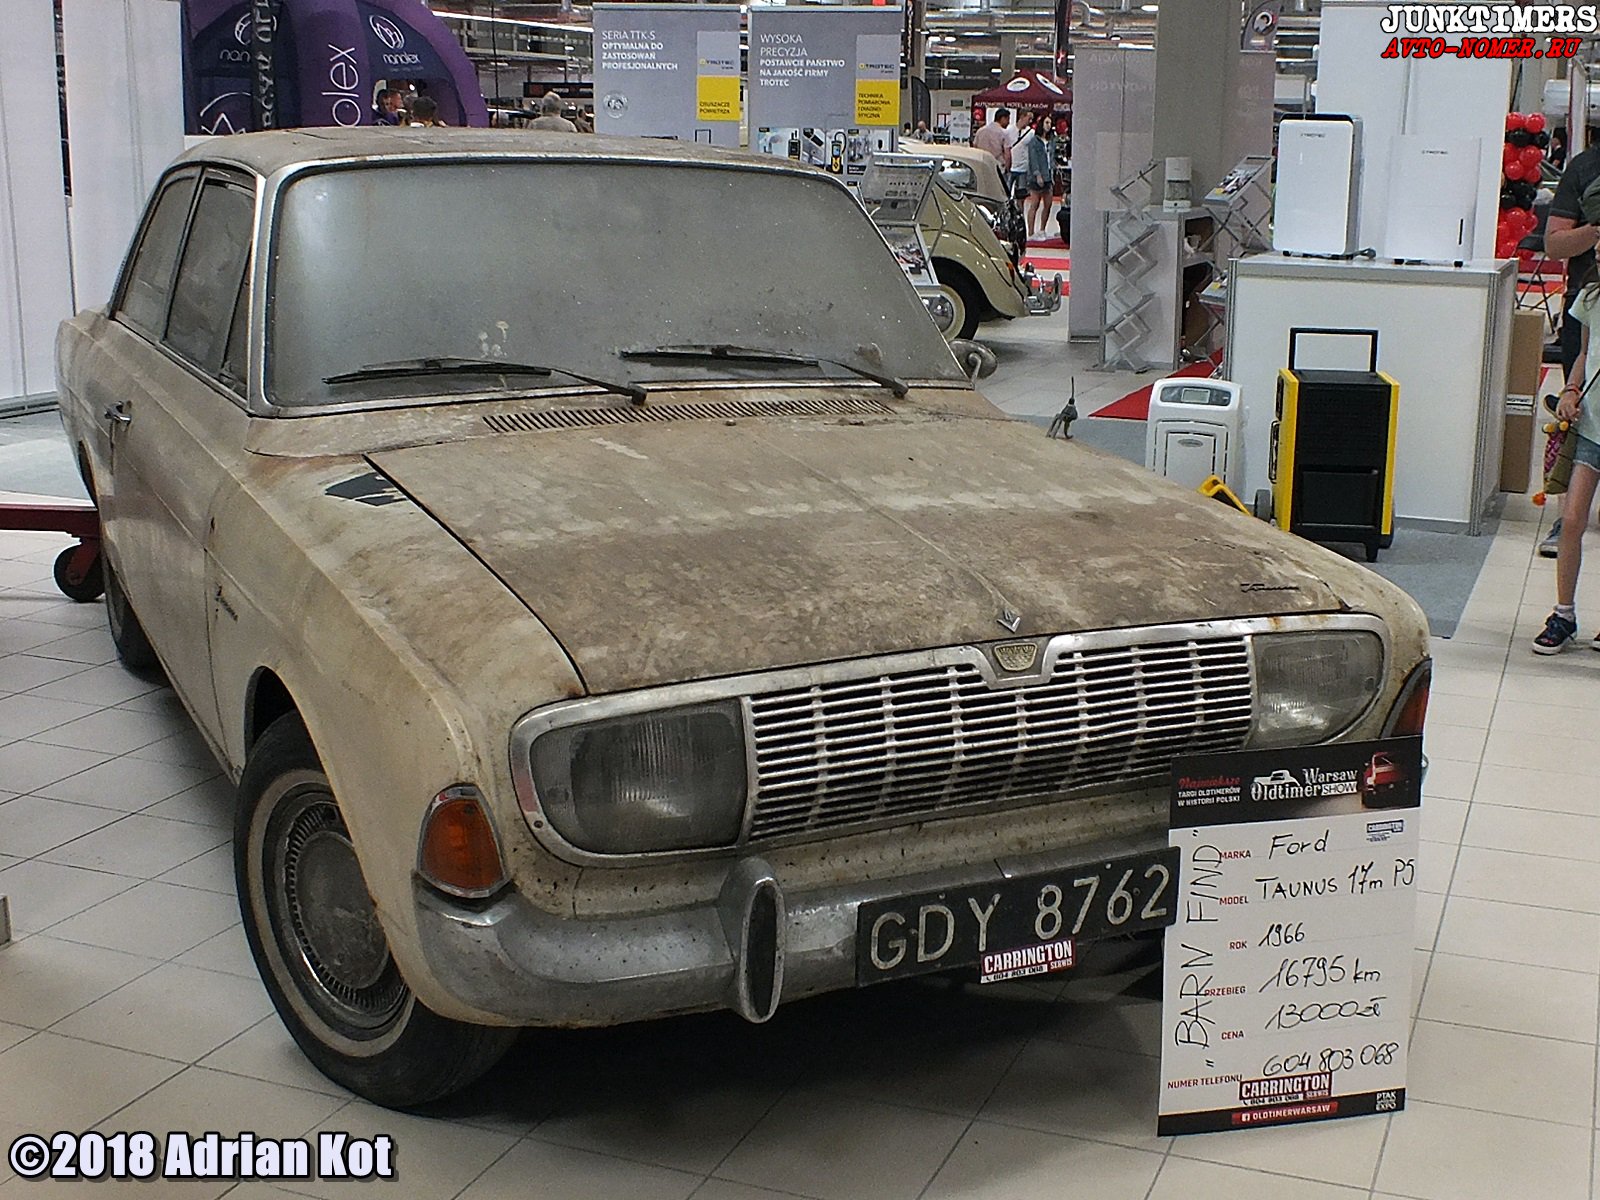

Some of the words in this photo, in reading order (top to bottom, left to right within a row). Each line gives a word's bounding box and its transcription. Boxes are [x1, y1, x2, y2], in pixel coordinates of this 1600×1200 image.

[602, 31, 628, 40] SERIA
[630, 30, 656, 40] TTK-S
[760, 34, 803, 44] WYSOKA
[383, 51, 421, 64] nanolex
[602, 51, 656, 59] ZASTOSOWAŃ
[760, 47, 808, 57] PRECYZJA
[602, 62, 678, 70] PROFESJONALNYCH
[806, 59, 845, 67] PAŃSTWO
[773, 68, 803, 77] JAKOŚĆ
[1302, 768, 1358, 784] Warsaw
[1178, 790, 1197, 798] TARGI
[1250, 782, 1321, 801] Oldtimer
[1322, 782, 1357, 795] SHOW
[1269, 829, 1329, 860] Ford
[1220, 850, 1250, 859] MARKA
[1255, 877, 1338, 899] TAUNUS
[1219, 896, 1249, 905] MODEL
[870, 893, 1001, 970] GDY
[1035, 864, 1170, 940] 8762
[1258, 923, 1305, 947] 1966
[1229, 941, 1247, 950] ROK
[984, 940, 1073, 974] CARRINGTON
[1050, 958, 1073, 969] SERWIS
[1259, 955, 1346, 993] 16795
[1353, 958, 1381, 983] km
[1205, 985, 1246, 996] PRZEBIEG
[1221, 1030, 1245, 1040] CENA
[1263, 1052, 1312, 1076] 604
[1319, 1048, 1354, 1072] 803
[1360, 1042, 1399, 1065] 068
[1167, 1080, 1198, 1089] NUMER
[1200, 1074, 1243, 1086] TELEFONU
[1242, 1074, 1330, 1098] CARRINGTON
[1252, 1105, 1331, 1121] OLDTIMERWARSAW
